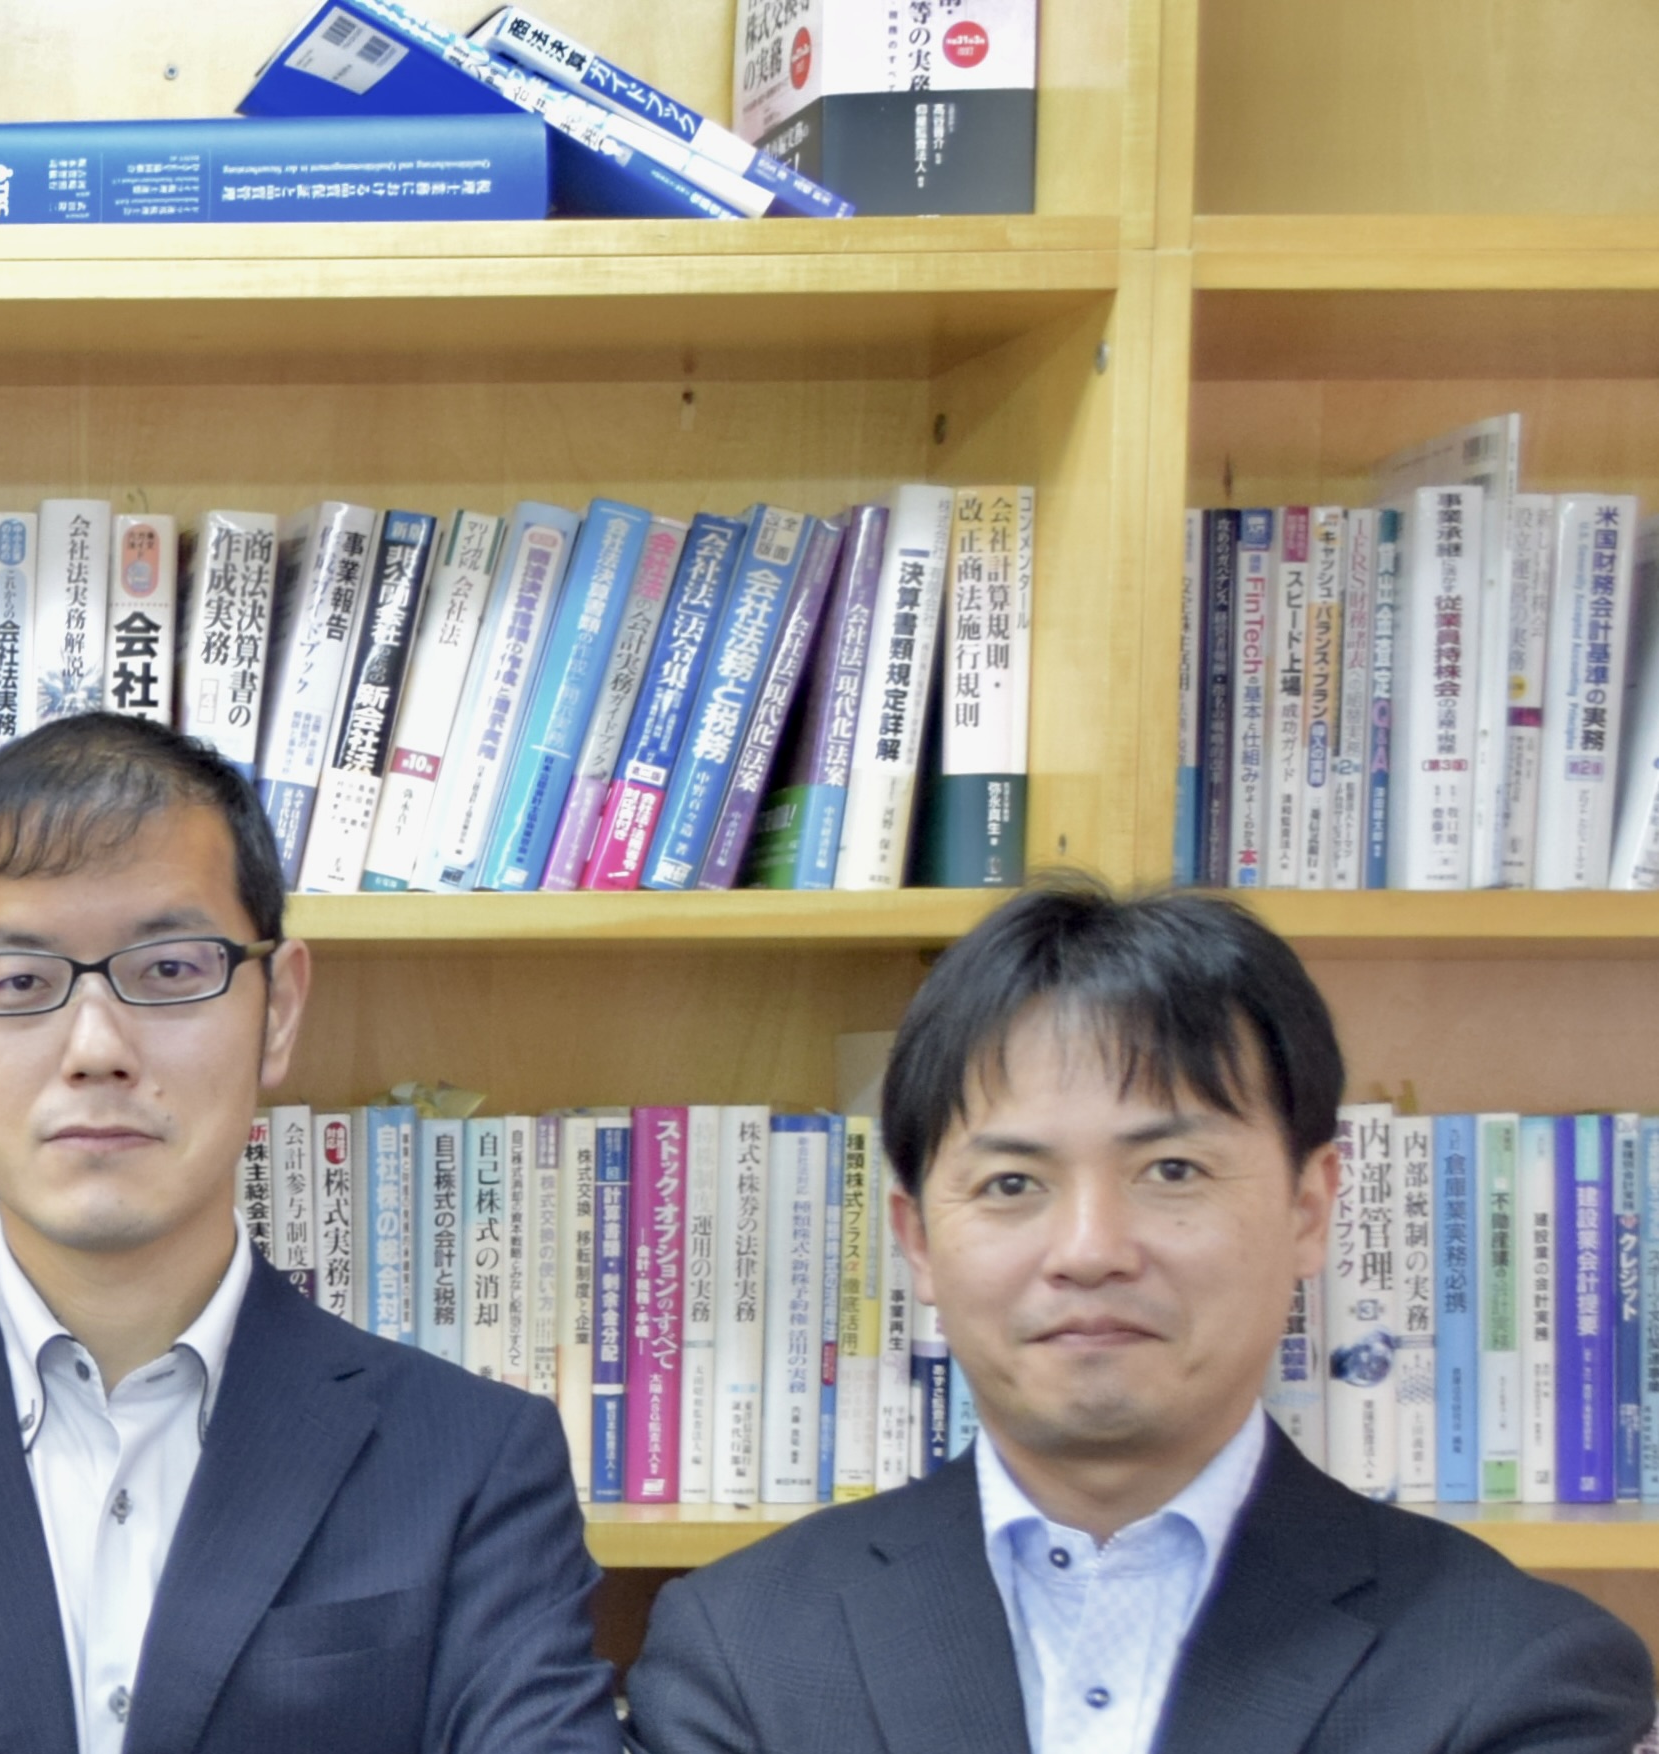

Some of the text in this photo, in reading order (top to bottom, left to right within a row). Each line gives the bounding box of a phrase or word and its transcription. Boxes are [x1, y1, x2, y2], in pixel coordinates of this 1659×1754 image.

[63, 513, 92, 678] 会社法実務解説
[200, 529, 241, 667] 作成実務
[227, 529, 273, 728] 商法決算書の
[325, 530, 368, 643] 事業報告
[437, 575, 475, 647] 会社法
[591, 530, 678, 767] 会社法の会計実務ガイドブック
[661, 523, 733, 689] 「会社法」法令集
[954, 498, 984, 729] 改正商法施行規則
[985, 498, 1013, 690] 会社計算規則・
[1016, 497, 1033, 630] コンメンタール
[1579, 506, 1619, 753] 米国財務会計基準の実務
[692, 568, 782, 764] 会社法務と税務
[824, 604, 869, 787] 会社法「現代化」法案
[875, 561, 924, 763] 決算書類規定詳解
[986, 782, 1003, 835] 弥永真生
[284, 1121, 308, 1286] 会計参与制度の
[432, 1133, 456, 1326] 自己株式の会計と税務
[473, 1132, 502, 1327] 自己株式の消却
[600, 1185, 621, 1363] 計算書類・剰余金分配
[649, 1119, 681, 1370] ストック・オプションのすべて
[734, 1121, 762, 1323] 株式・株券の法律実務
[1335, 1120, 1355, 1278] 実務ハンドブック
[1358, 1117, 1394, 1292] 内部管理
[1403, 1129, 1430, 1333] 内部統制の実務
[1443, 1152, 1468, 1315] 倉庫業実務必携
[1533, 1212, 1550, 1341] 建設業の会計実務
[1575, 1187, 1600, 1337] 建設業会計提要
[1619, 1232, 1637, 1322] クレジット
[888, 1288, 905, 1353] 事業再生
[933, 1364, 945, 1443] あずさ監査法人
